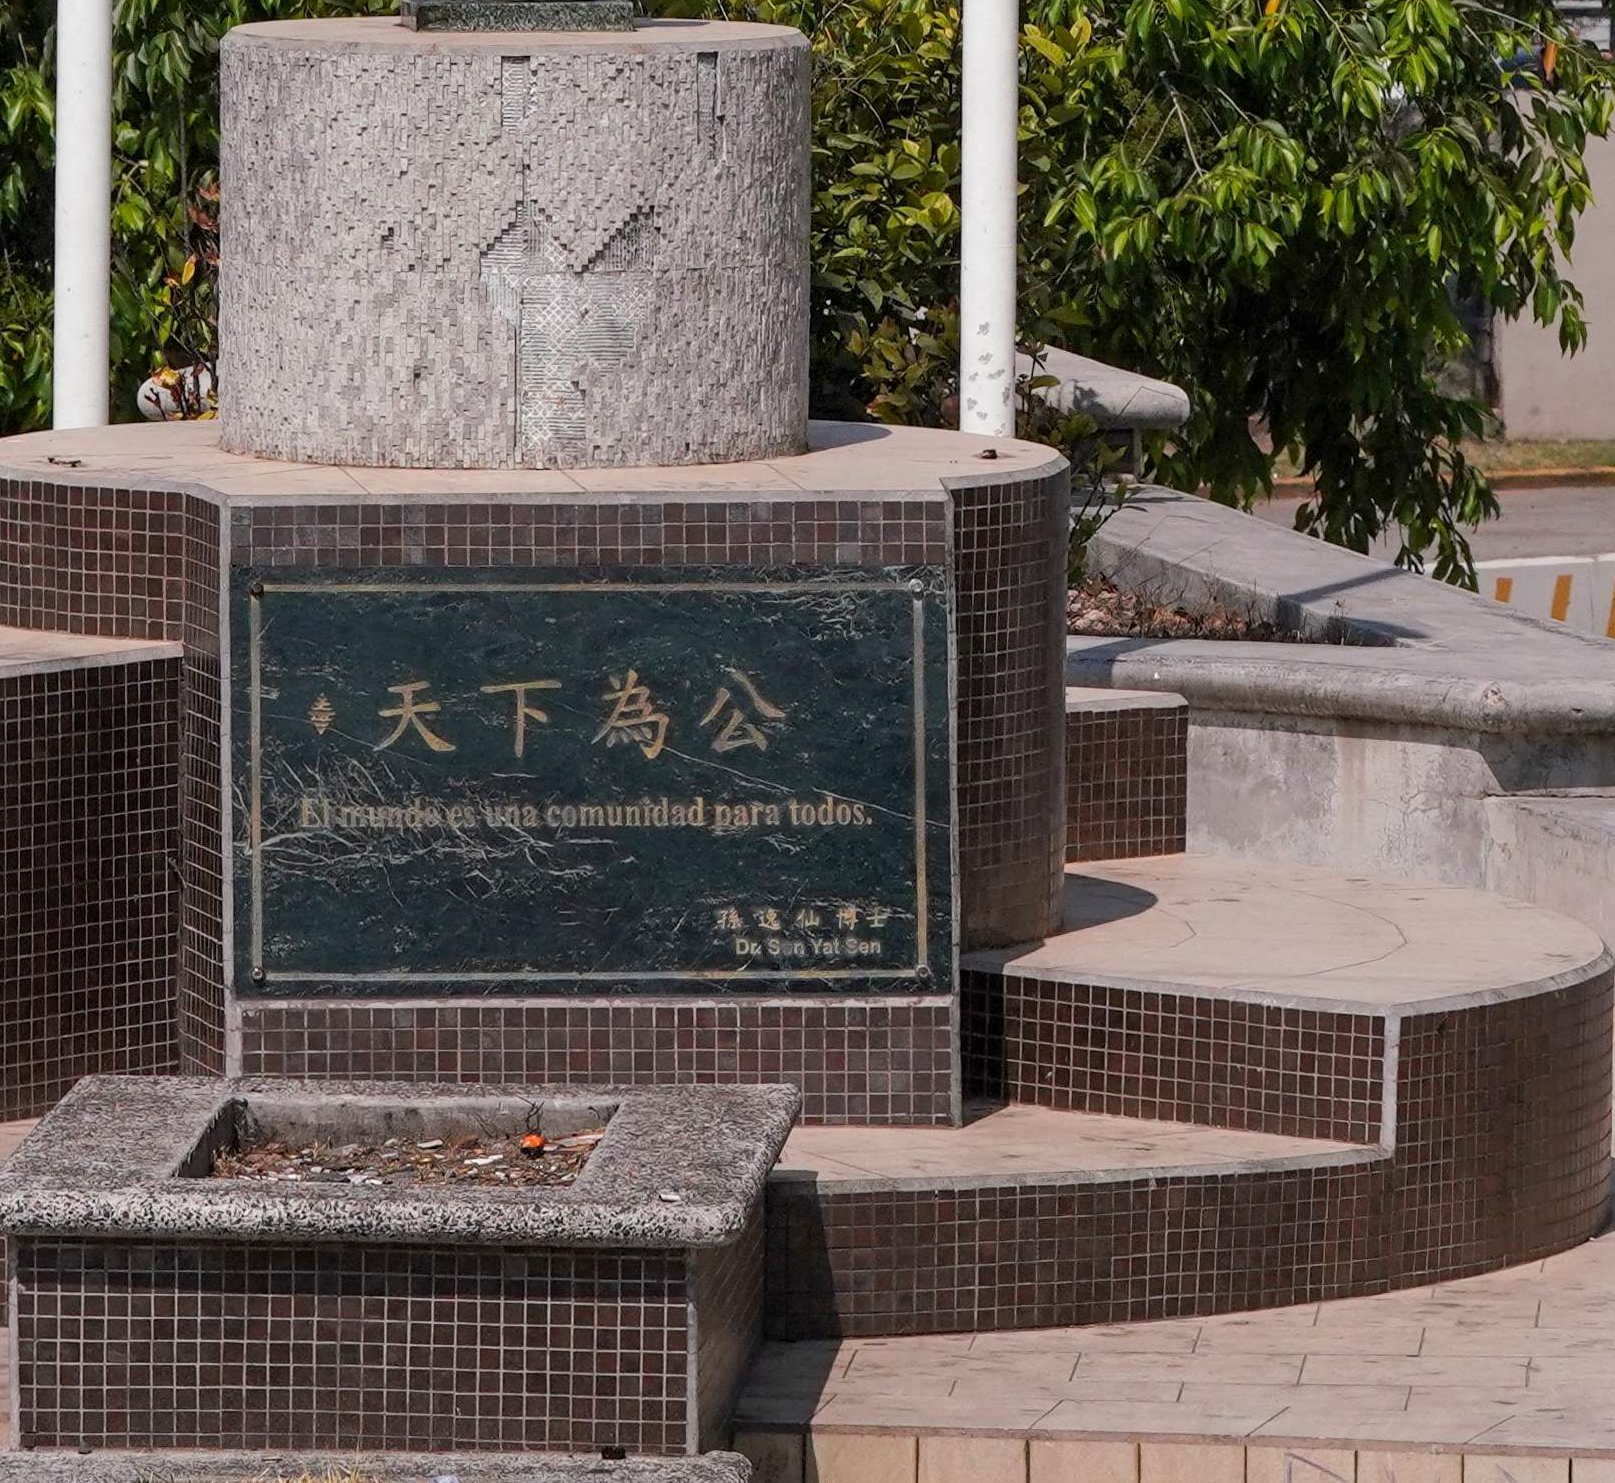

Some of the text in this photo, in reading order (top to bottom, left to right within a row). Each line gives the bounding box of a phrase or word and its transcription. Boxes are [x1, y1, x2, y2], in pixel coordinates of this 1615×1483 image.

[373, 668, 786, 760] 天下為公
[299, 796, 874, 833] El mundo es una comunidad para todos.
[812, 938, 841, 956] Yat
[845, 938, 882, 956] Sen
